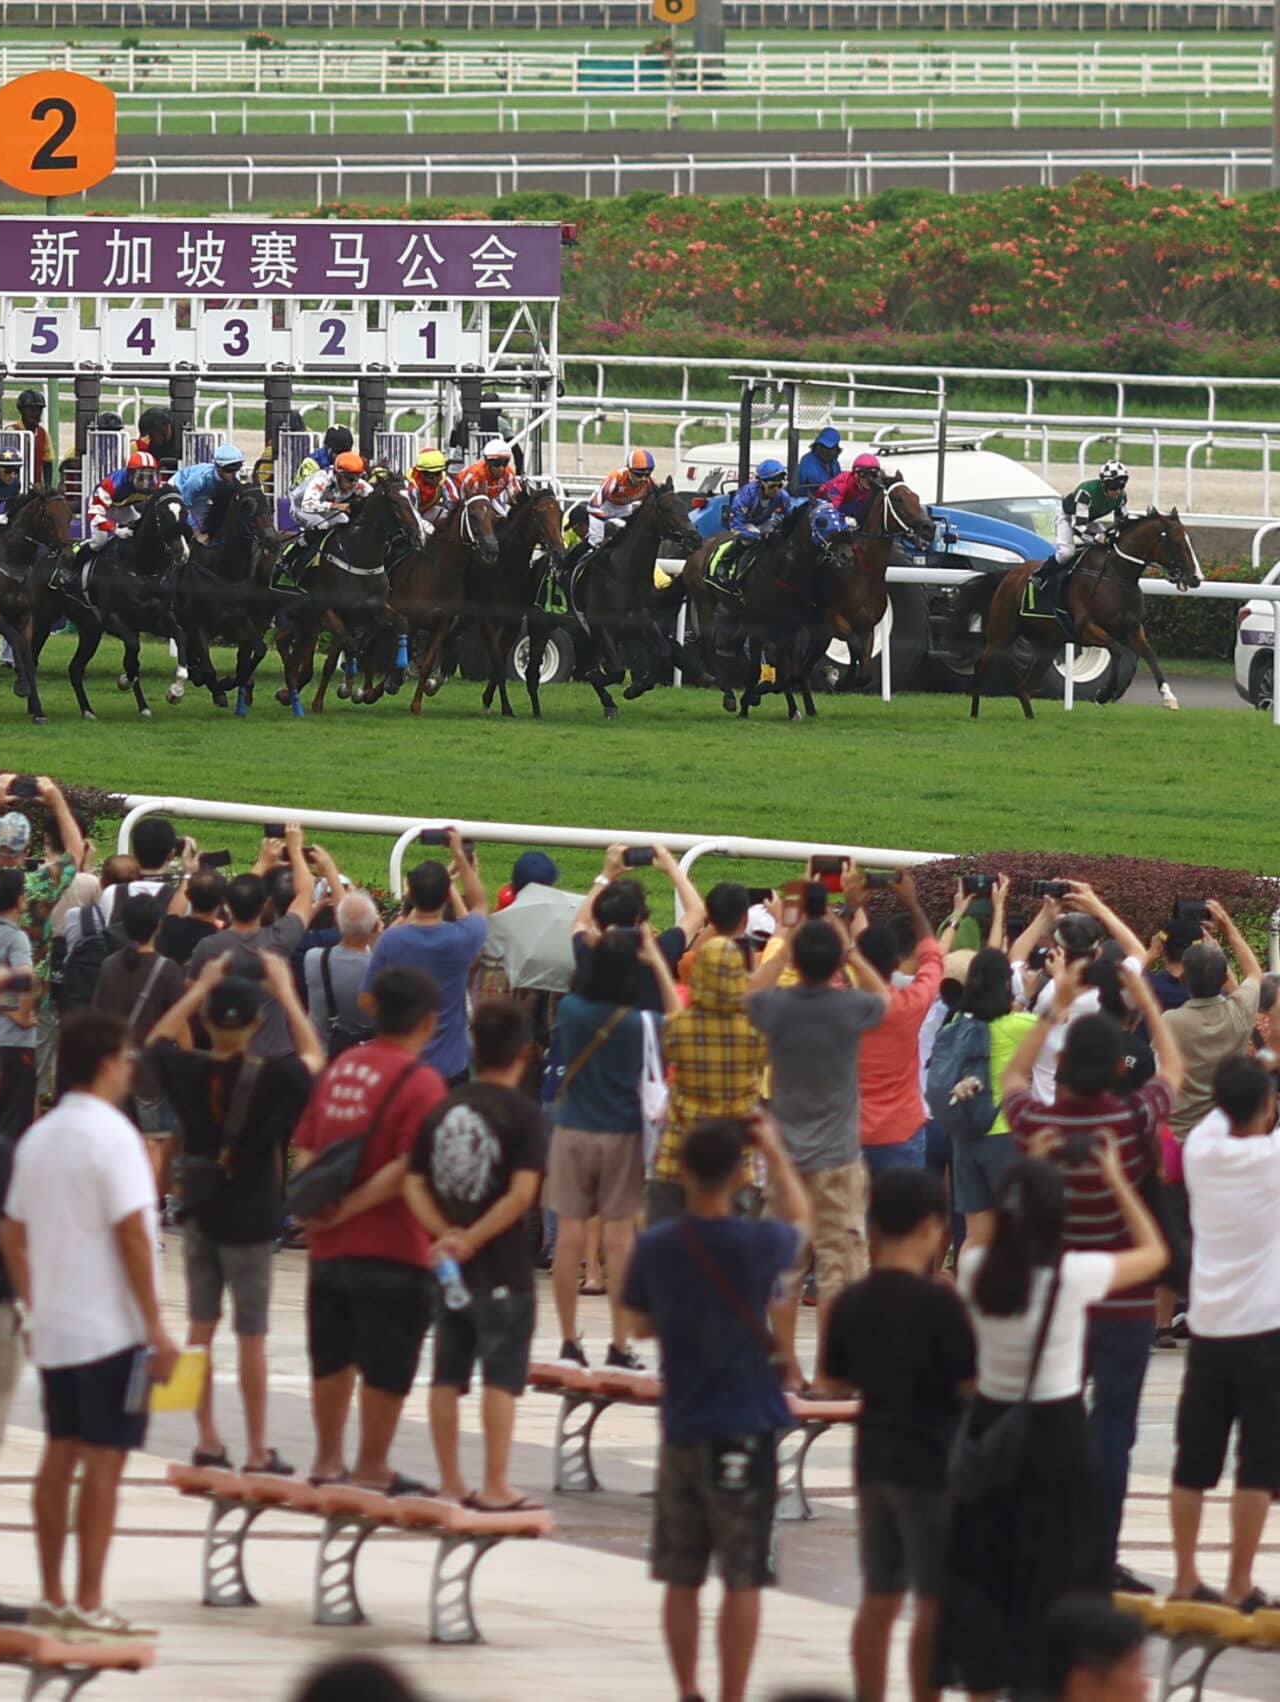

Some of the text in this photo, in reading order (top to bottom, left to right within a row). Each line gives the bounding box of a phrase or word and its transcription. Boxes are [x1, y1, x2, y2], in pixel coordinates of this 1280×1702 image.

[30, 97, 78, 170] 2
[29, 228, 518, 290] 新加坡赛马公会
[30, 317, 59, 354] 5
[126, 317, 156, 356] 4
[223, 319, 250, 357] 3
[319, 319, 346, 356] 2
[419, 321, 437, 359] 1
